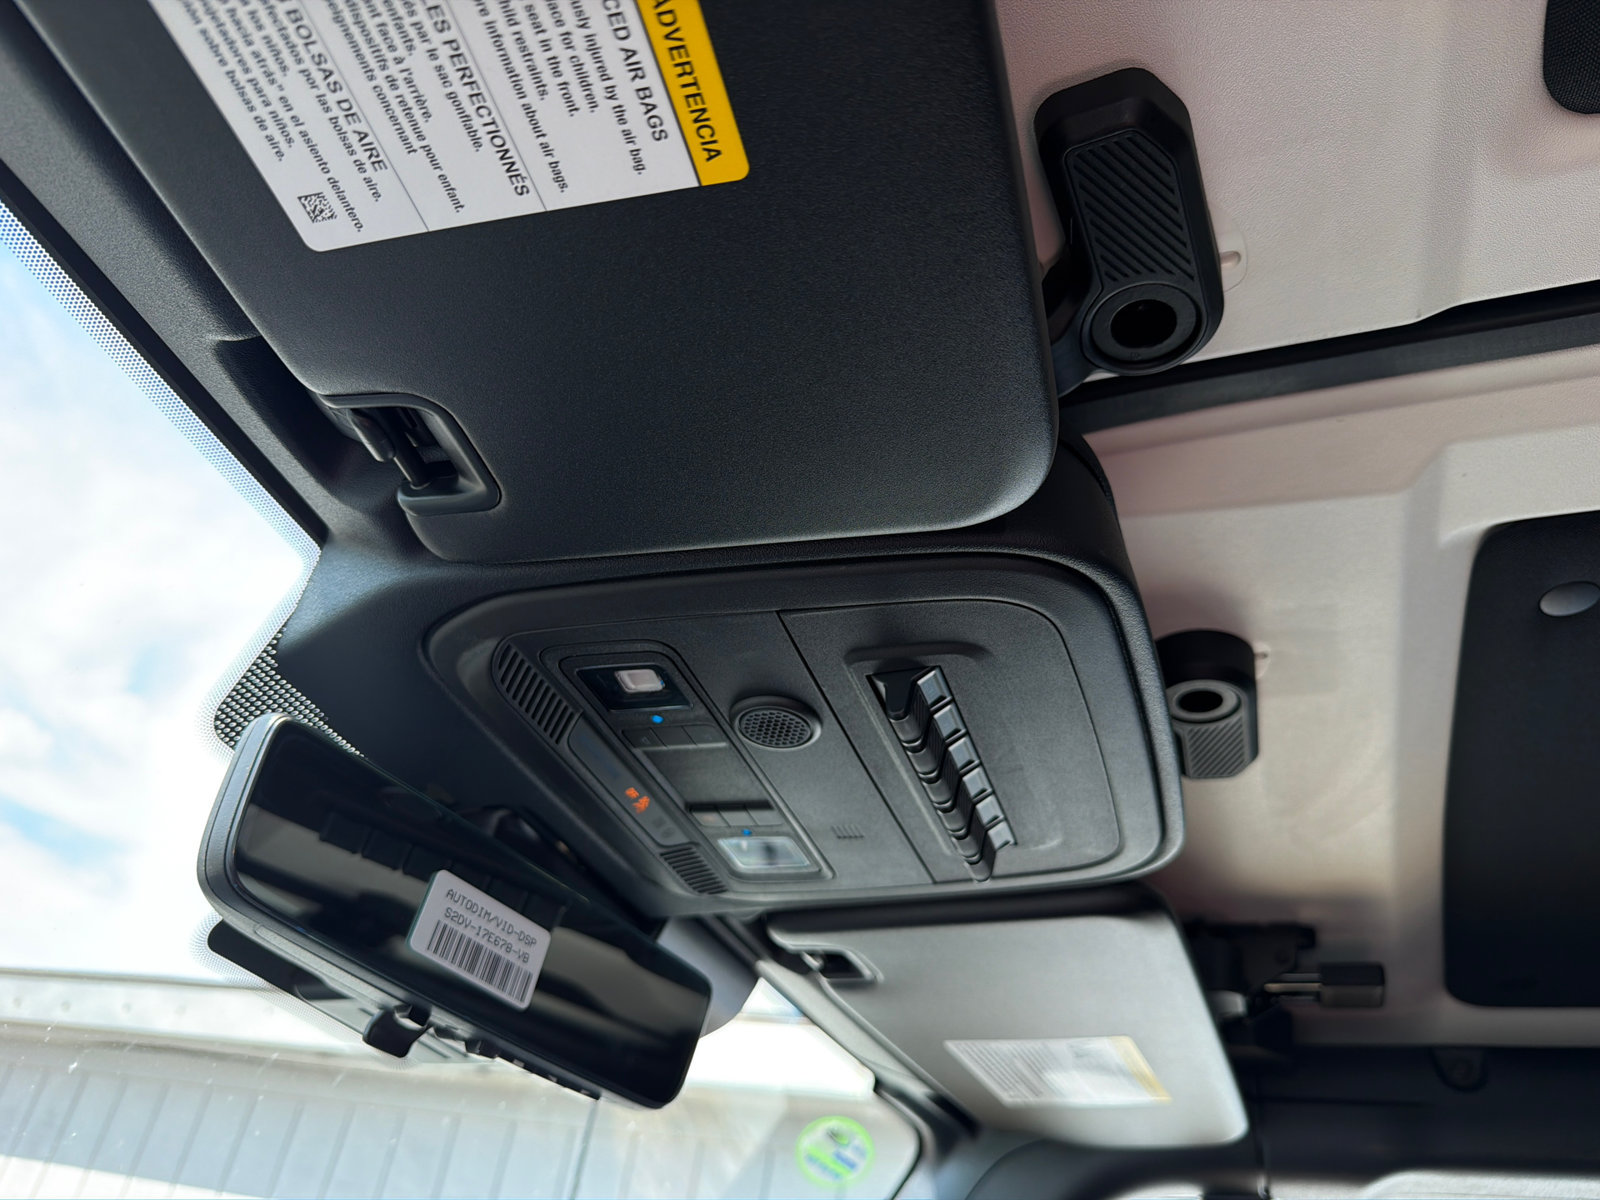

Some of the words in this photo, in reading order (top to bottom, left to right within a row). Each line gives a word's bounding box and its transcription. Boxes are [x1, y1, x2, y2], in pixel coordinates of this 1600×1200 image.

[246, 9, 266, 33] los
[261, 34, 290, 77] niños.
[375, 21, 398, 53] face
[392, 56, 406, 66] à
[409, 20, 432, 45] par
[425, 47, 440, 62] le
[434, 64, 453, 89] sac
[444, 91, 483, 153] gonflable.
[511, 30, 549, 101] restraints.
[523, 3, 548, 36] seat
[538, 38, 553, 53] in
[546, 55, 564, 78] the
[556, 81, 581, 117] front.
[559, 30, 575, 51] for
[568, 55, 599, 113] children.
[198, 27, 229, 68] sobre
[224, 69, 257, 113] bolsas
[252, 115, 269, 132] de
[264, 134, 285, 162] aire.
[225, 7, 255, 48] hacia
[278, 95, 294, 113] en
[289, 114, 305, 128] el
[298, 130, 331, 175] asiento
[326, 176, 364, 233] delantero.
[246, 77, 273, 108] para
[268, 110, 295, 149] niños.
[284, 8, 344, 94] BOLSAS
[335, 98, 362, 126] DE
[352, 129, 388, 172] AIRE
[297, 68, 320, 91] por
[315, 93, 333, 114] las
[327, 115, 358, 157] bolsas
[352, 158, 368, 174] de
[362, 176, 382, 203] aire.
[372, 84, 418, 155] concernant
[398, 67, 433, 123] l'arrière.
[442, 38, 530, 197] PERFECTIONNÉS
[483, 20, 528, 100] information
[521, 103, 548, 139] about
[538, 141, 555, 158] air
[547, 160, 569, 193] bags.
[583, 33, 614, 82] injured
[603, 84, 619, 101] by
[611, 104, 628, 126] the
[621, 128, 637, 146] air
[629, 148, 646, 175] bag.
[619, 47, 646, 82] AIR
[634, 86, 669, 142] BAGS
[384, 74, 400, 91] de
[394, 94, 427, 142] retenue
[418, 144, 443, 171] pour
[437, 173, 465, 213] enfant.
[446, 888, 537, 948] AUTODIM/VID-DSP
